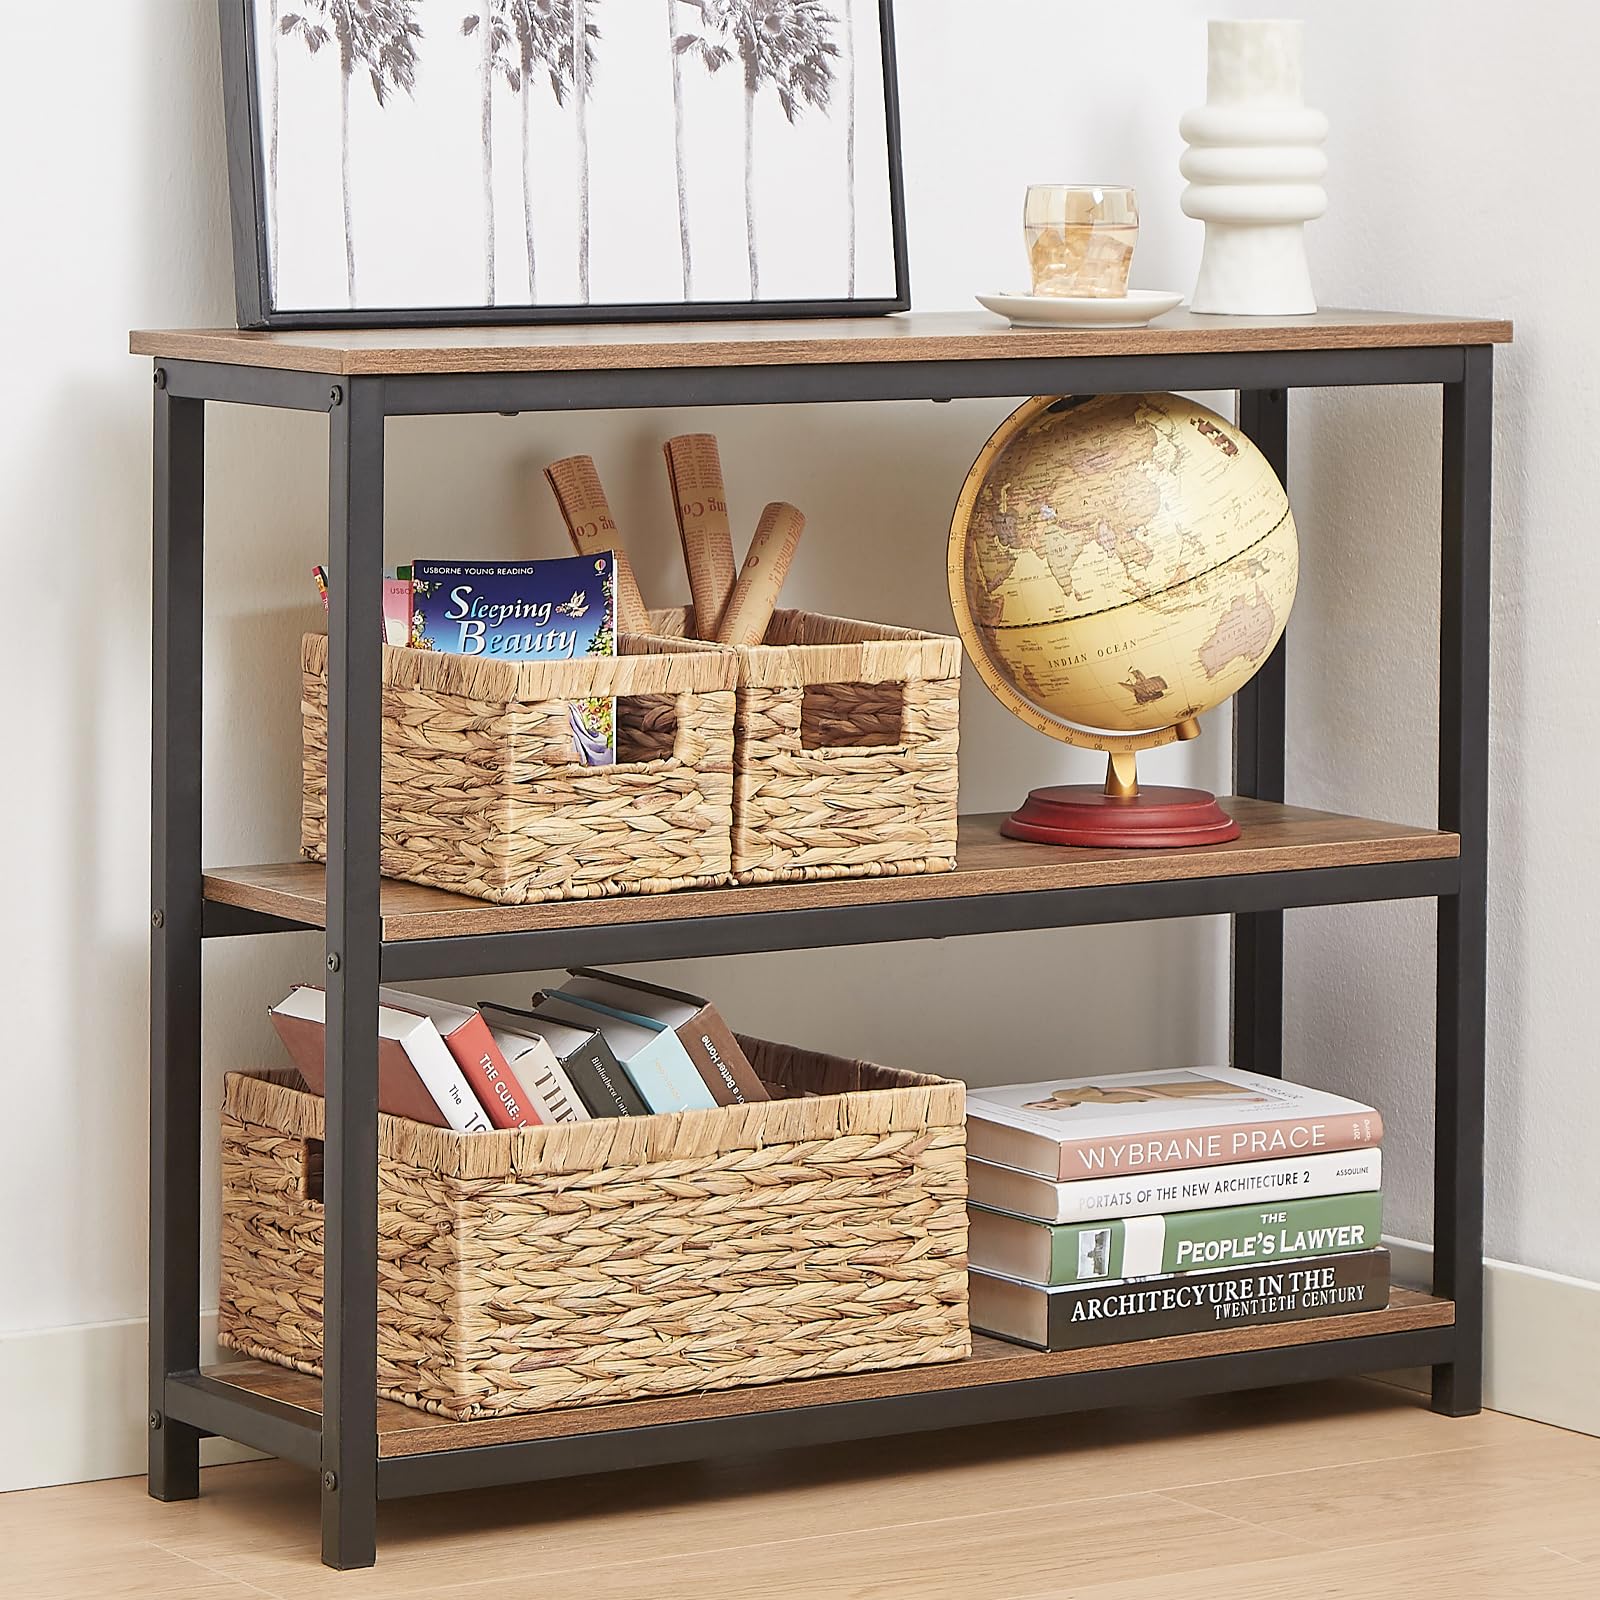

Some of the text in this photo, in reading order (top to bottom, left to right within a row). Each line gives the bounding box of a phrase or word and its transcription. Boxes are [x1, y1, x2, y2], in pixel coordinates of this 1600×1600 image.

[423, 566, 534, 575] USBORNE YOUNG READING
[444, 585, 553, 627] Sleeping
[456, 619, 578, 658] Beauty
[1048, 639, 1137, 668] INDIAN OCEAN
[701, 1035, 721, 1064] Home
[479, 1053, 520, 1121] THE CURE:
[716, 1061, 736, 1089] Better
[449, 1083, 462, 1105] The
[732, 1086, 740, 1094] a
[1077, 1124, 1326, 1170] WYBRANE PRACE
[1335, 1166, 1369, 1177] ASSOULINE
[1079, 1171, 1311, 1211] PORTATS OF THE NEW ARCHITECTURE 2
[1260, 1212, 1287, 1224] THE
[1280, 1225, 1365, 1253] LAWYER
[1070, 1267, 1336, 1322] ARCHITECYURE IN THE
[1213, 1285, 1366, 1320] TWENTIETH CENTURY
